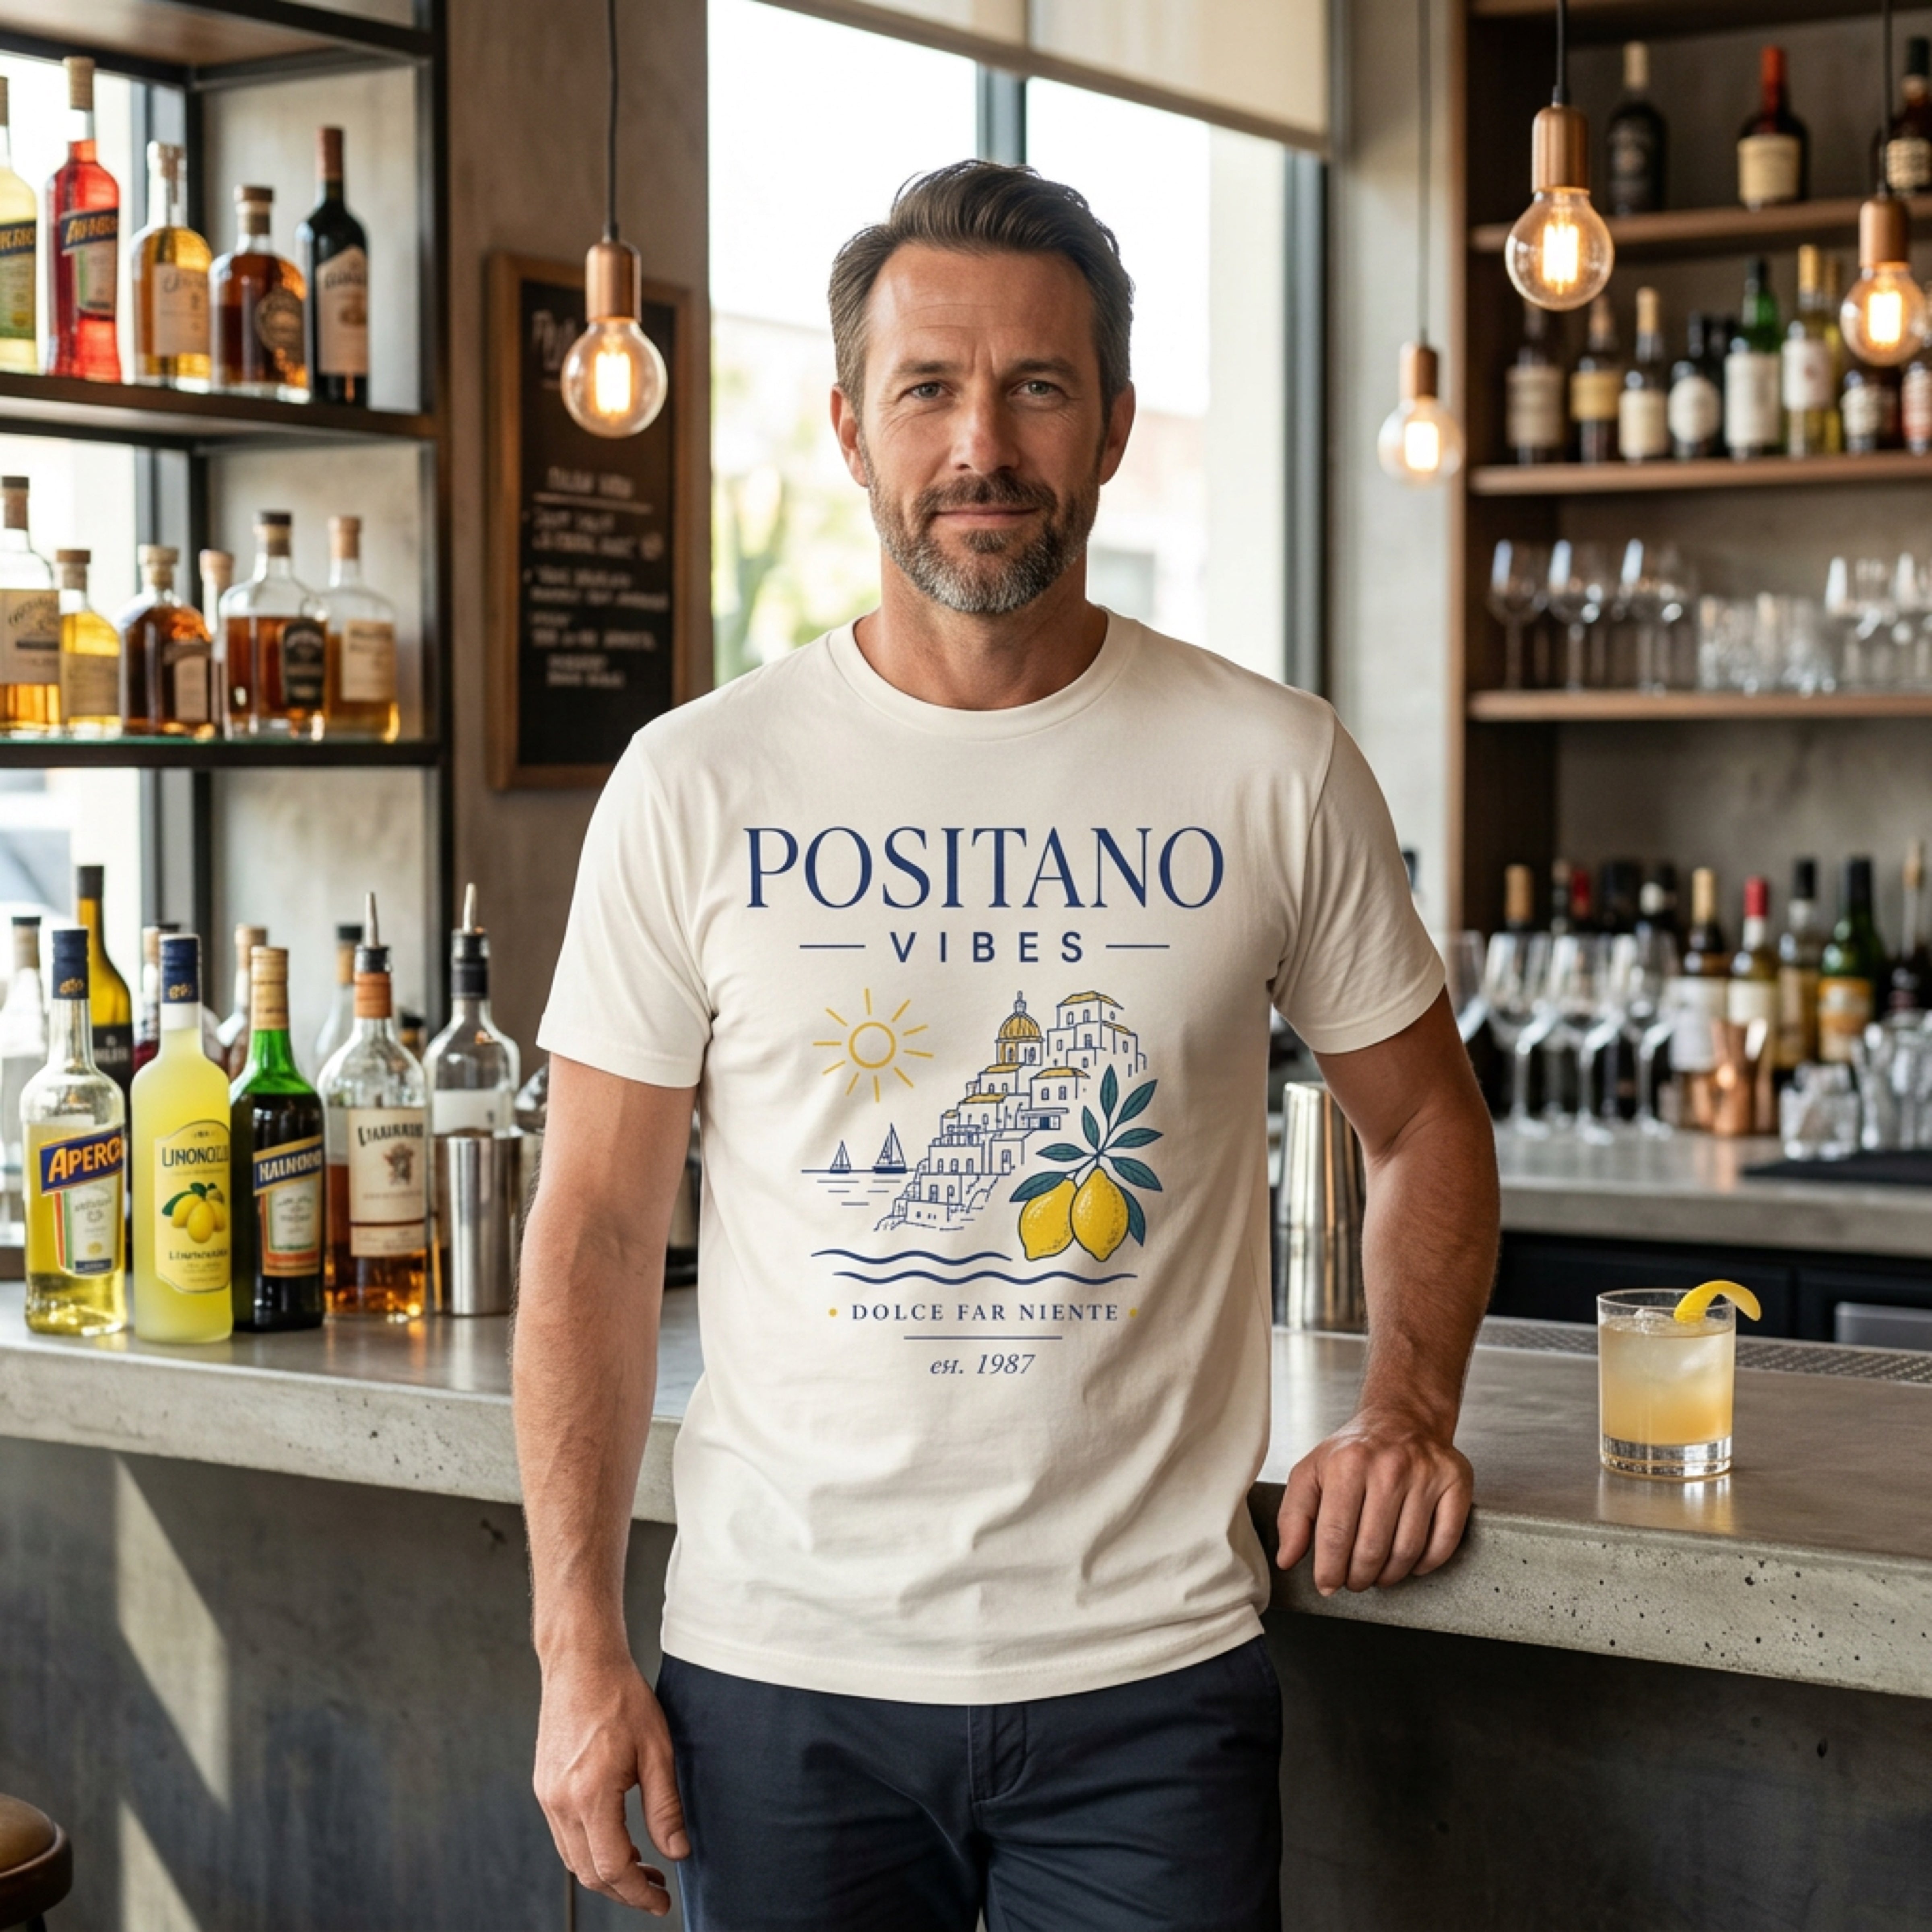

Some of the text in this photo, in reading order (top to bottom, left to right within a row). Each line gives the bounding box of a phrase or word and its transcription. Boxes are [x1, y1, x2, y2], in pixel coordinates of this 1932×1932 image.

[743, 826, 1225, 910] POSITANO
[890, 931, 1084, 963] VIBES
[852, 1304, 1118, 1321] DOLCE FAR NIENTE
[977, 1353, 1036, 1375] 1987
